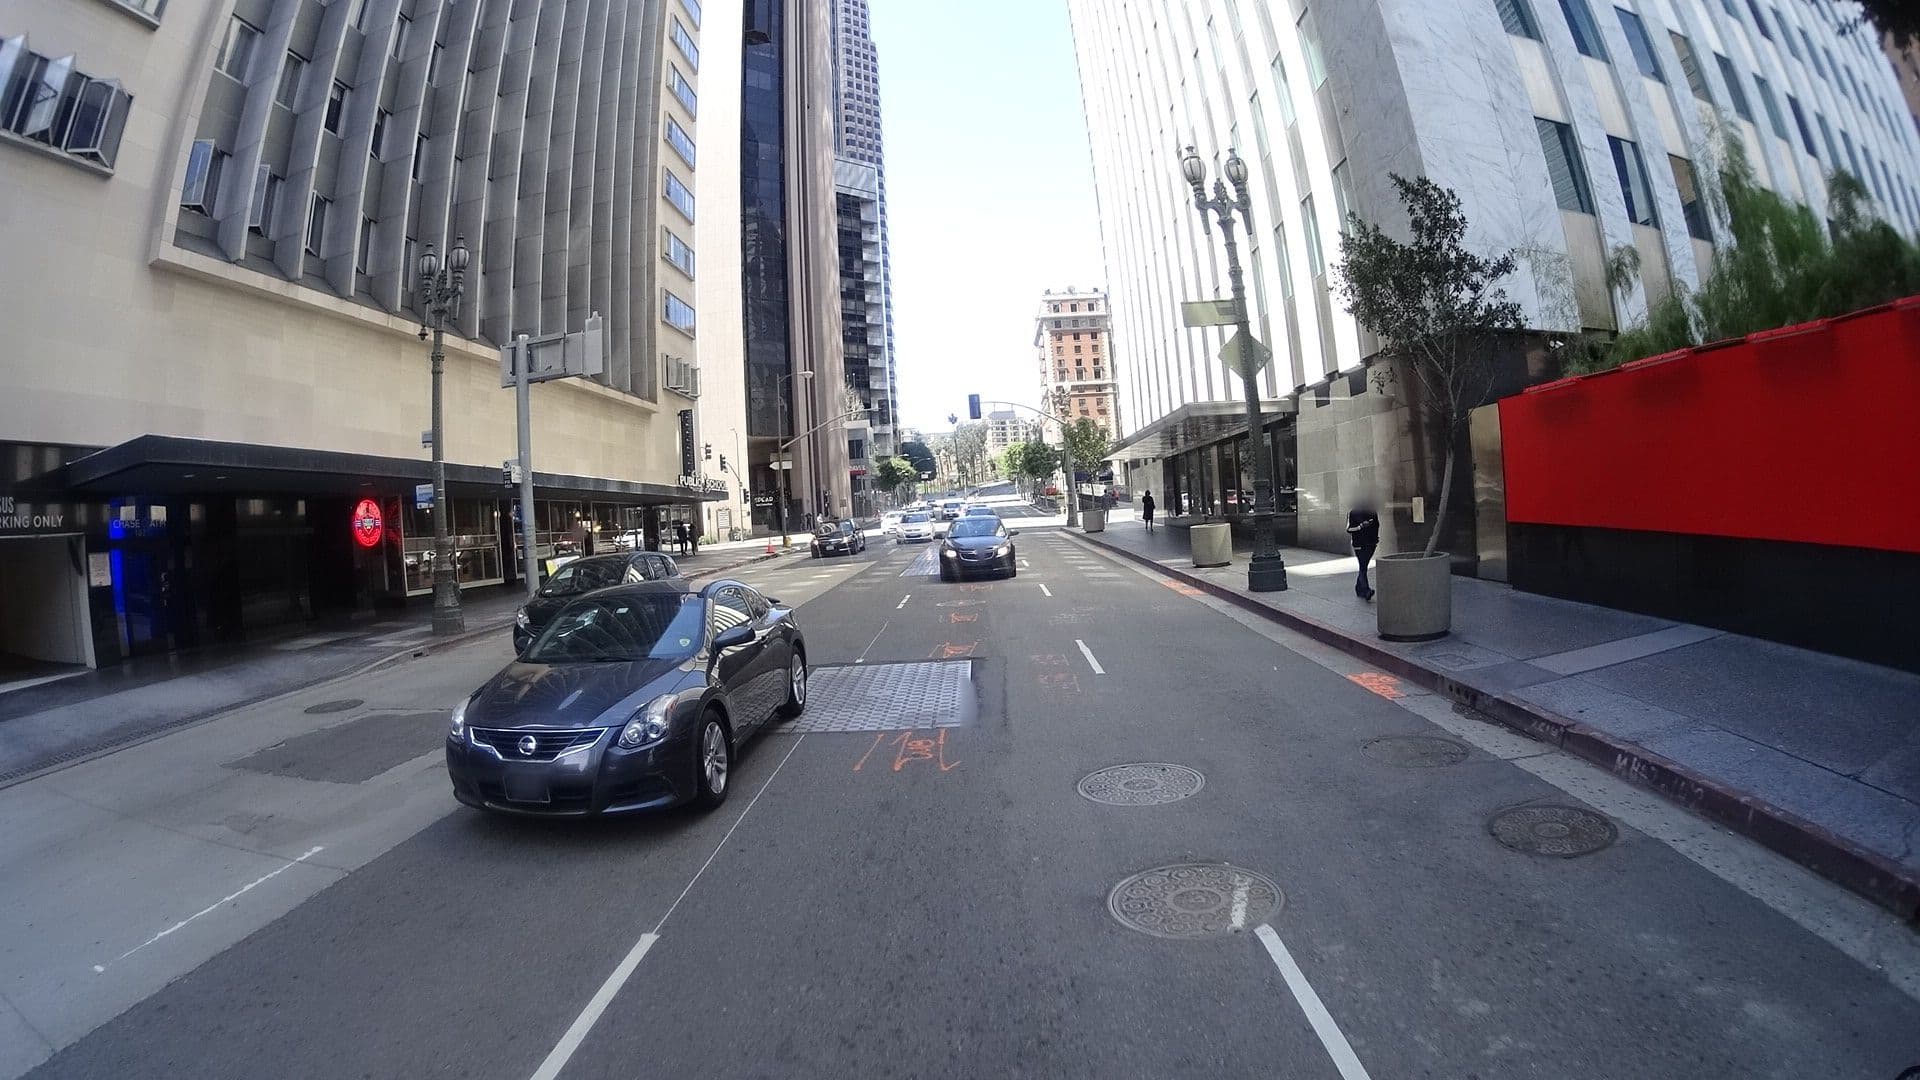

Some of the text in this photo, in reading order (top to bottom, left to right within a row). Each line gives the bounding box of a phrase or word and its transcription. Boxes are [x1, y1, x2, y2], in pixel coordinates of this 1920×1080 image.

[680, 475, 703, 487] PUBLIC
[33, 515, 63, 528] ONLY
[113, 519, 141, 529] CHASE
